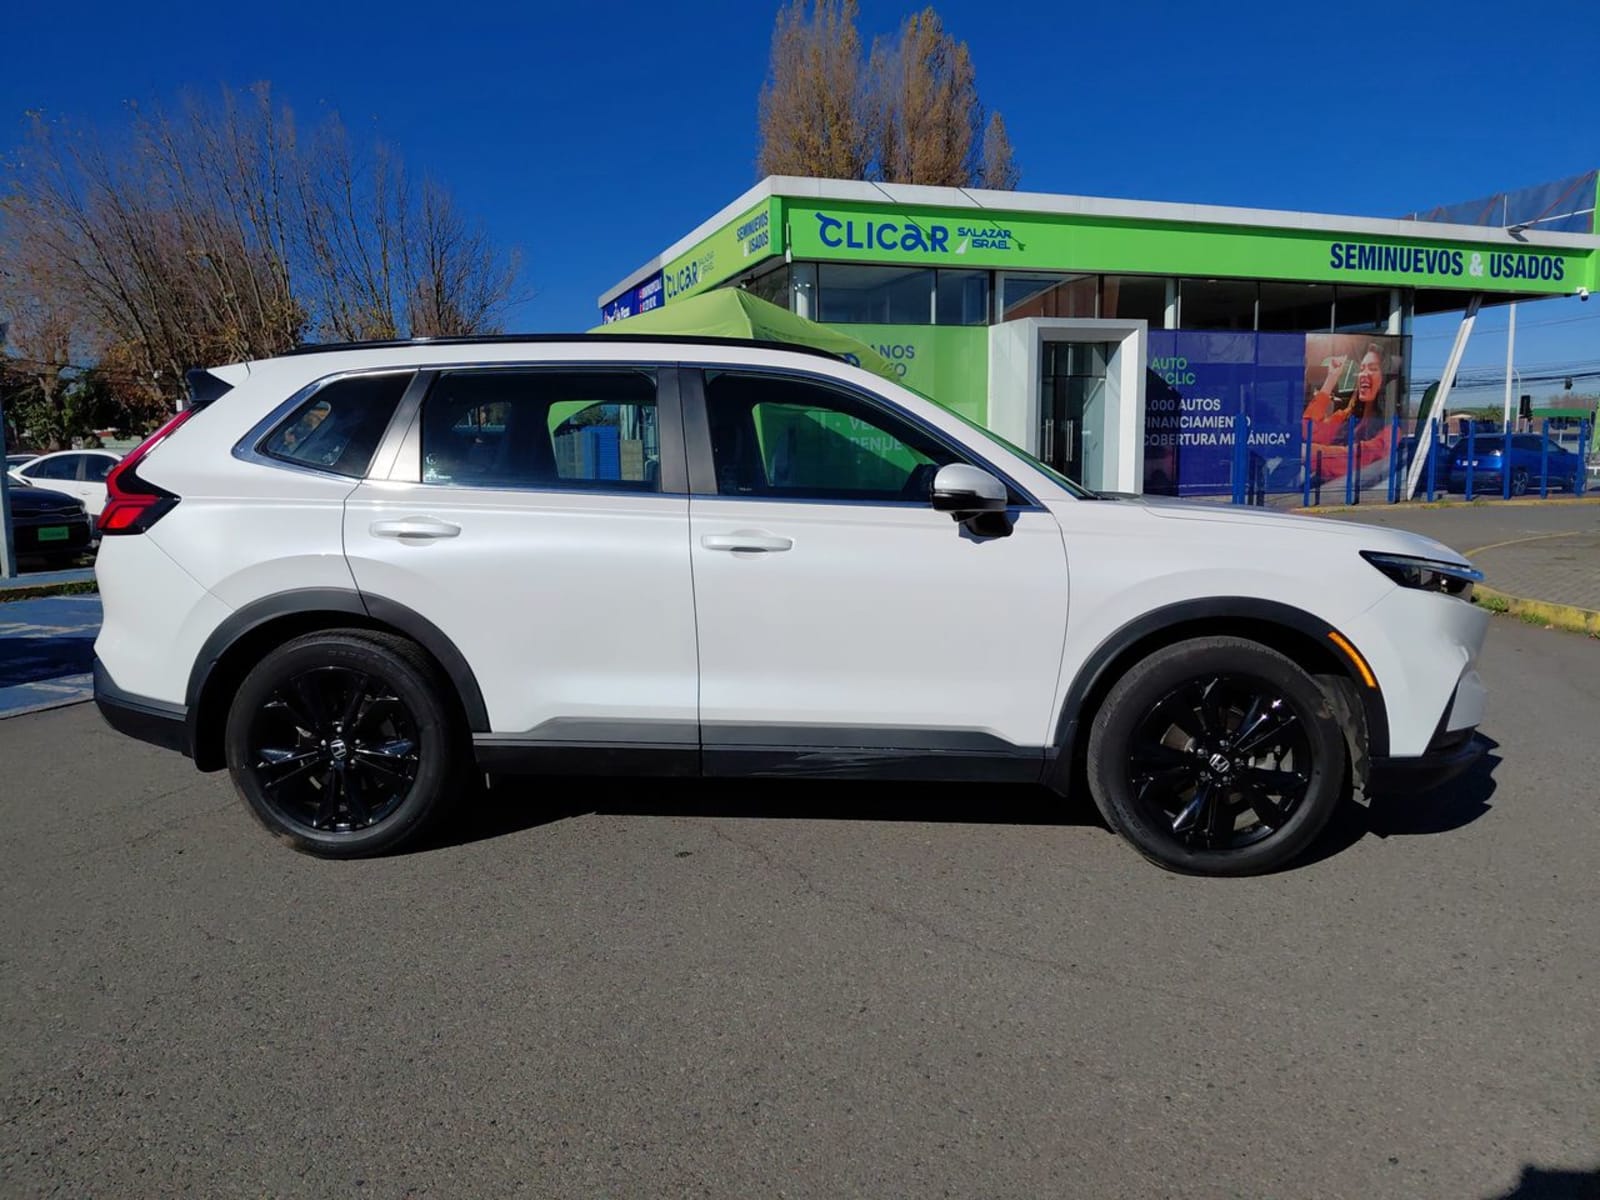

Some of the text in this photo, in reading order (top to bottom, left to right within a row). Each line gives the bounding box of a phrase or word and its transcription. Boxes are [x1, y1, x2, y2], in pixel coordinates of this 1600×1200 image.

[957, 226, 1012, 239] SALAZAR
[972, 238, 1011, 250] ISRAEL
[1329, 242, 1564, 281] SEMINUEVOS & USADOS
[1151, 357, 1188, 371] AUTO
[1164, 372, 1196, 385] CLIC
[1178, 398, 1221, 411] AUTOS
